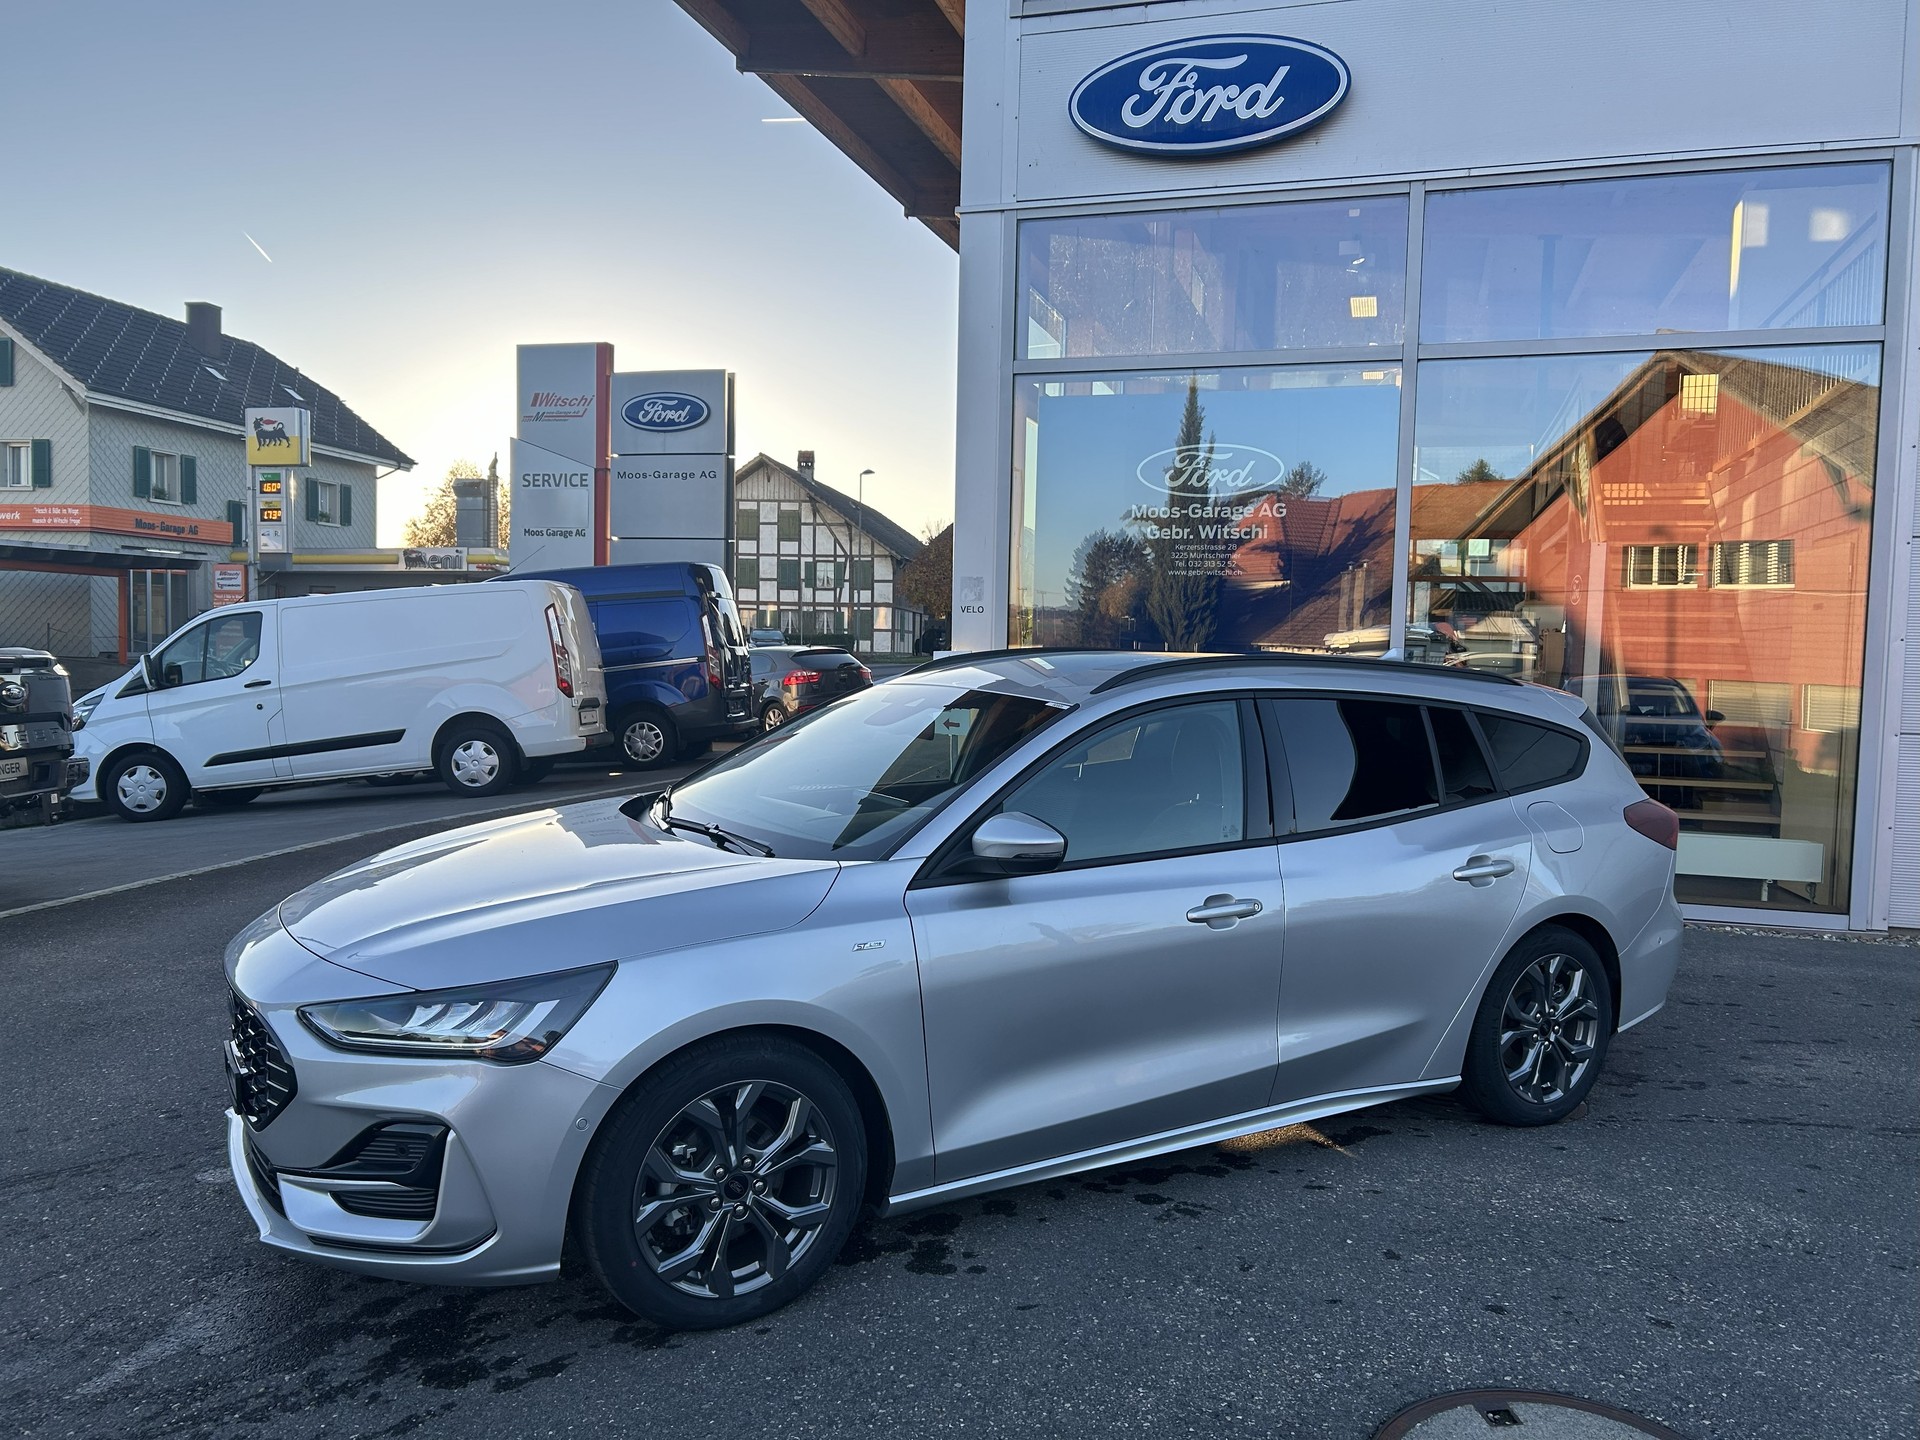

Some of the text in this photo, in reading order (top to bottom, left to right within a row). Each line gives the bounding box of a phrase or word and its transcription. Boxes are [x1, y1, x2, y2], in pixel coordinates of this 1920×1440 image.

[1121, 54, 1291, 128] Ford
[538, 392, 595, 407] Witschi
[638, 399, 691, 423] Ford
[617, 470, 717, 480] Moos-Garage AG
[1165, 452, 1256, 488] Ford
[522, 473, 589, 488] SERVICE
[1131, 503, 1287, 520] Moos-Garage AG
[135, 518, 199, 535] Moos-Garage AG
[523, 528, 586, 539] Moos Garage AG
[1147, 525, 1268, 539] Gebr. Witschi
[1168, 569, 1243, 577] www.gebr-witschi.ch
[960, 605, 985, 614] VELO
